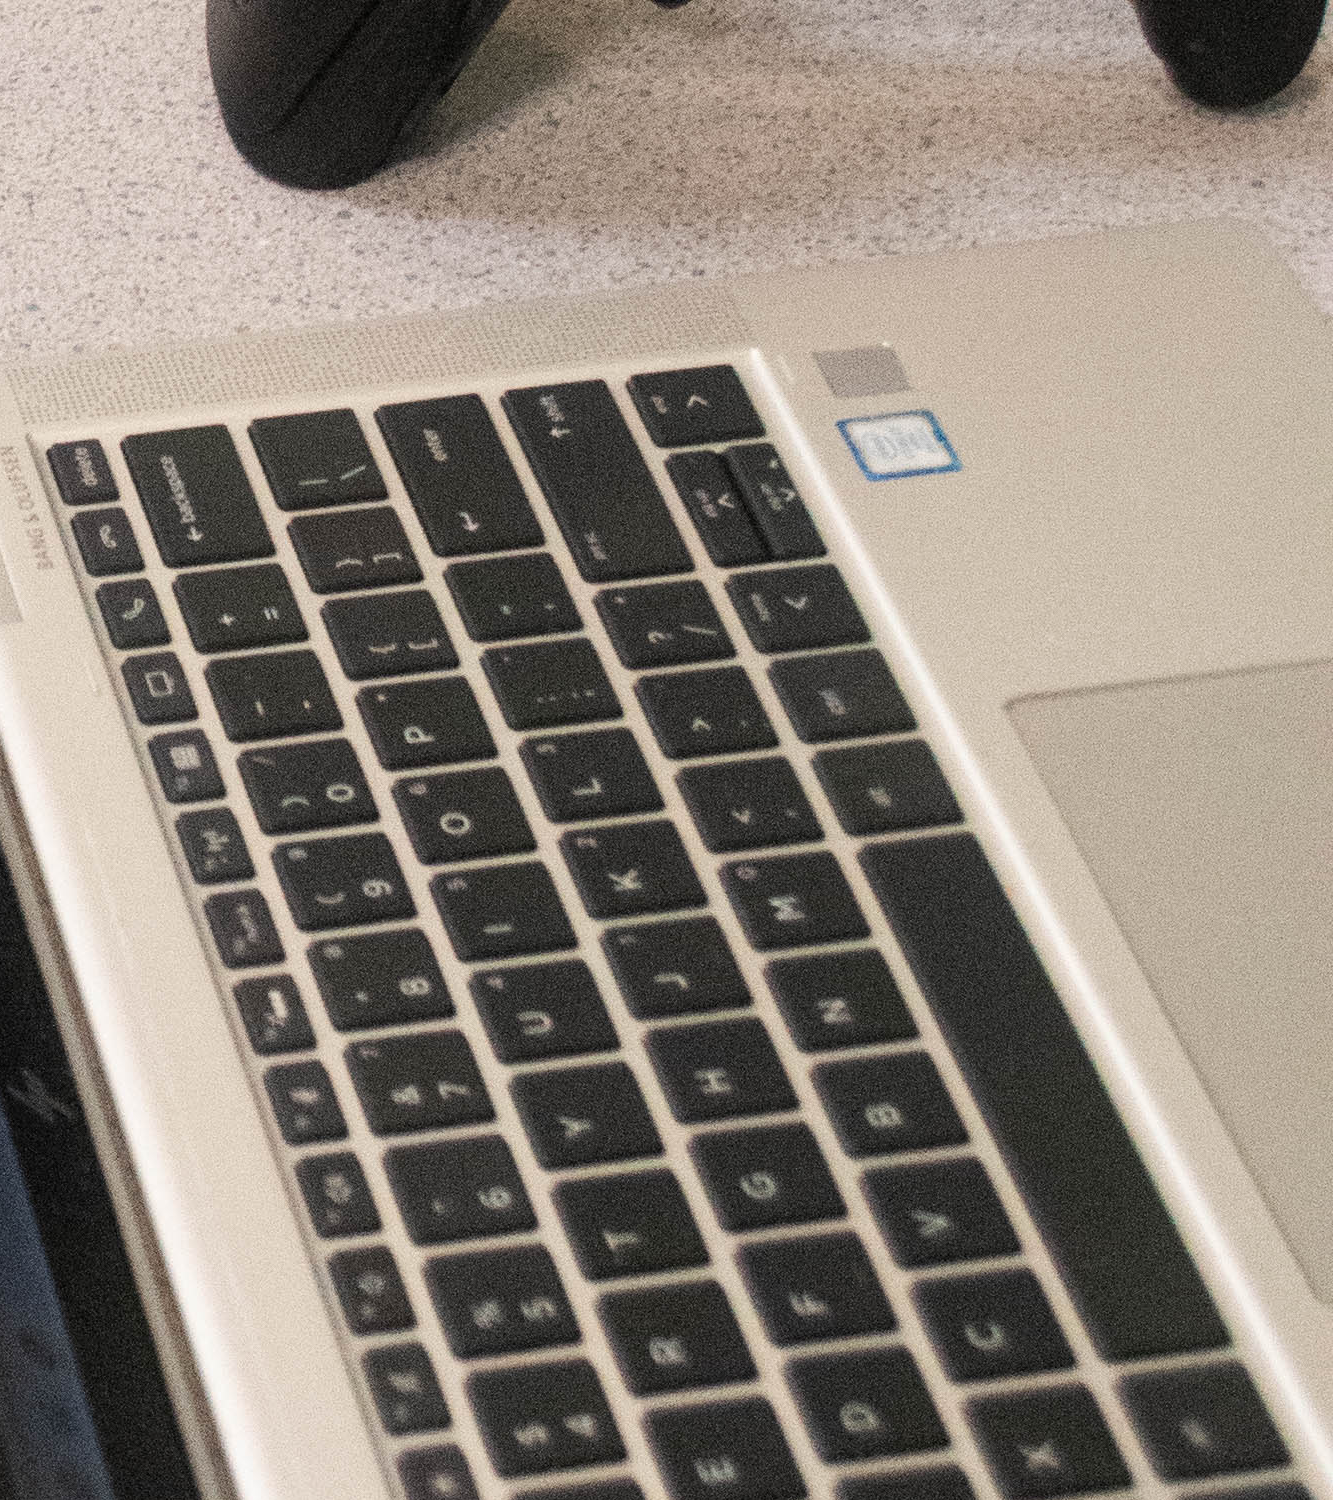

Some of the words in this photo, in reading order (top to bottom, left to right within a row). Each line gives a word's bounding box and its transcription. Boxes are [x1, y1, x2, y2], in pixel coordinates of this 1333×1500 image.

[539, 394, 565, 423] shift
[423, 428, 448, 462] enter
[0, 445, 38, 509] OLUFSEN
[75, 446, 98, 486] delete
[160, 455, 196, 524] backspace
[25, 527, 54, 569] BANG
[403, 725, 434, 744] P
[325, 783, 356, 803] 0
[573, 777, 603, 796] L
[439, 812, 472, 836] O
[362, 879, 393, 898] 9
[610, 870, 641, 890] K
[769, 896, 803, 921] M
[484, 923, 513, 935] I
[399, 977, 431, 996] 8
[655, 973, 689, 989] J
[819, 998, 850, 1023] N
[519, 1011, 553, 1035] U
[437, 1082, 468, 1099] 7
[698, 1069, 731, 1094] H
[560, 1117, 590, 1137] Y
[865, 1103, 902, 1128] B
[740, 1172, 778, 1200] G
[479, 1188, 512, 1209] 6
[915, 1212, 950, 1236] V
[603, 1231, 638, 1251] T
[521, 1298, 556, 1320] 5
[790, 1294, 826, 1316] F
[965, 1324, 1005, 1351] C
[650, 1340, 684, 1364] R
[567, 1414, 595, 1437] 4
[840, 1403, 880, 1432] D
[1024, 1444, 1058, 1467] X
[696, 1460, 736, 1483] E
